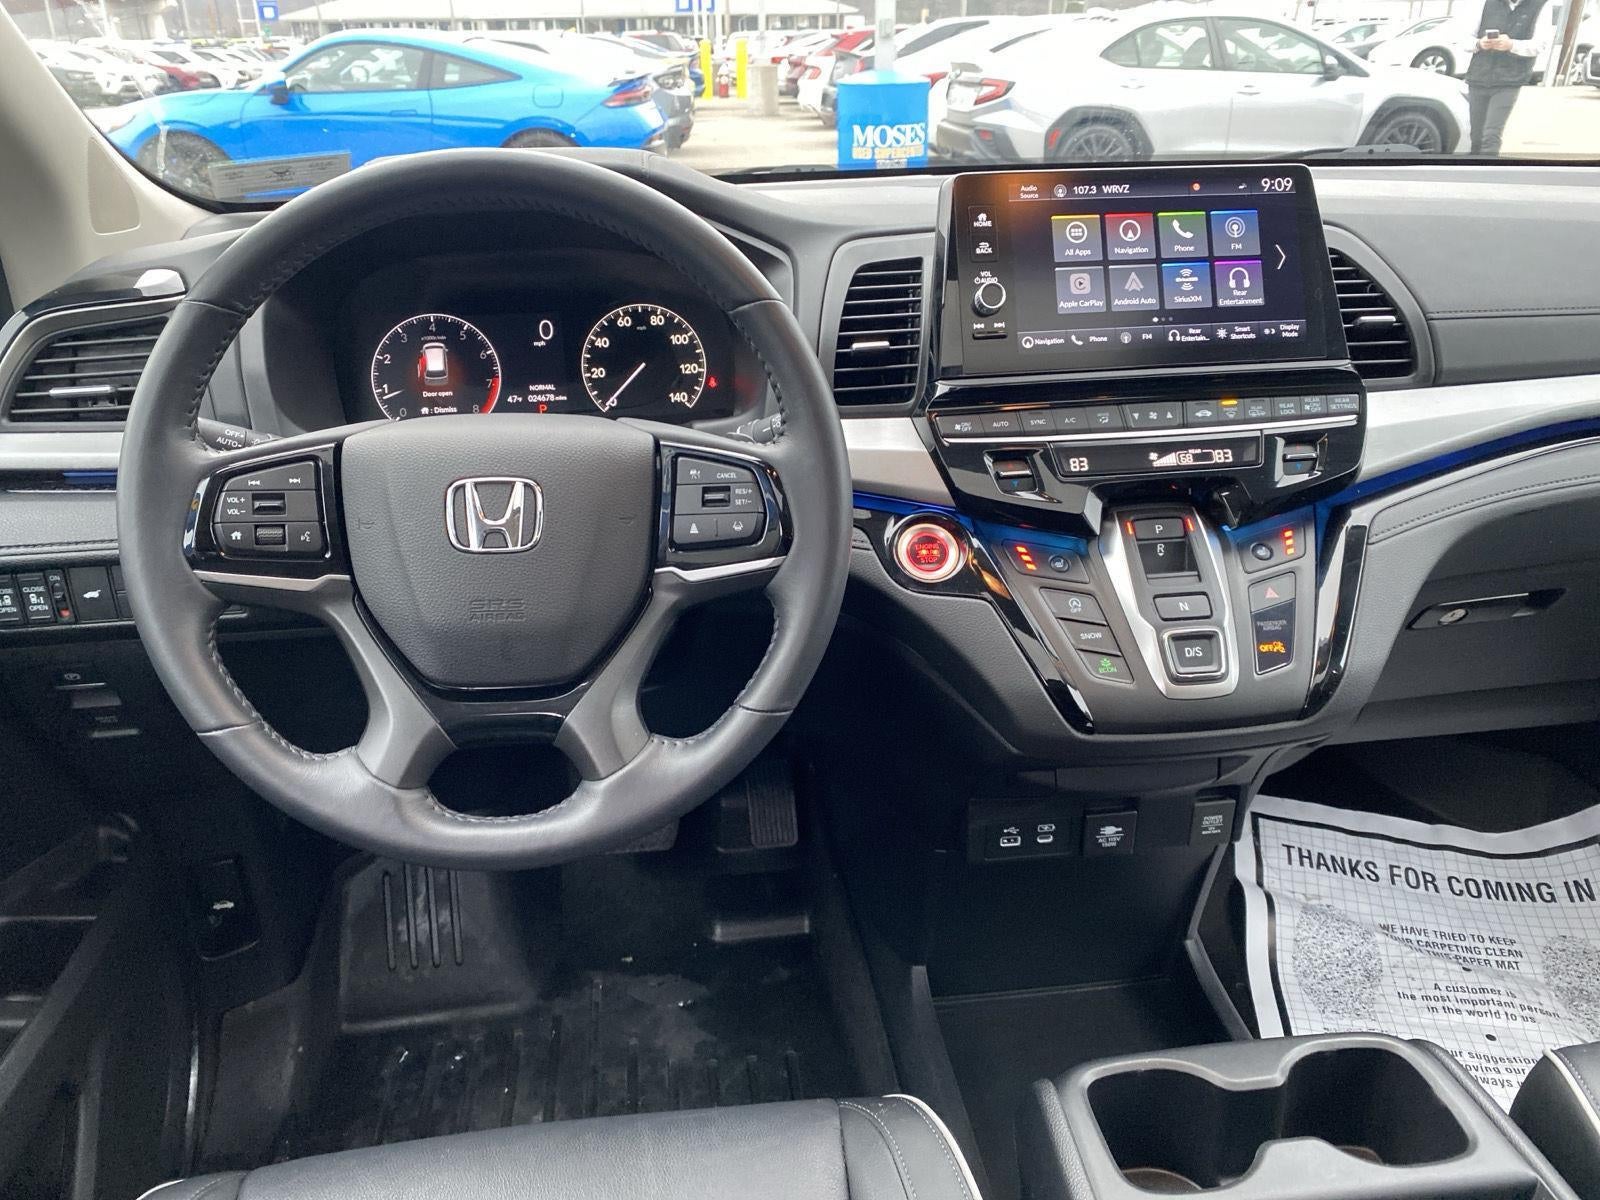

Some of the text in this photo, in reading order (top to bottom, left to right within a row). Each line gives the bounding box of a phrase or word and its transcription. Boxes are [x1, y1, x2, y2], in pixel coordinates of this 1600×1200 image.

[852, 122, 926, 148] MOSES
[1073, 184, 1130, 194] 107.3 WRVZ
[1262, 177, 1292, 192] 9:09
[1074, 248, 1091, 257] Apps
[1114, 246, 1148, 256] Navigation
[1079, 300, 1104, 308] CarPlay
[1174, 296, 1202, 304] SiriusXM
[616, 316, 632, 327] 60
[650, 315, 665, 326] 80
[428, 323, 436, 332] 4
[539, 320, 554, 340] 0
[400, 334, 408, 342] 3
[460, 330, 466, 340] 5
[670, 334, 689, 344] 100
[594, 337, 610, 348] 40
[1034, 338, 1065, 346] Navigation
[384, 354, 392, 364] 2
[480, 350, 487, 360] 6
[590, 368, 606, 378] 20
[680, 363, 698, 374] 120
[528, 394, 555, 402] 024678
[669, 392, 688, 403] 140
[400, 408, 407, 417] 0
[472, 404, 480, 414] 8
[539, 404, 548, 414] P
[224, 428, 240, 438] OFF
[216, 436, 238, 448] AUTO
[1178, 454, 1193, 463] 68
[1215, 449, 1233, 463] 83
[1070, 458, 1088, 472] 83
[1155, 524, 1164, 534] P
[1156, 544, 1165, 553] R
[1179, 602, 1190, 612] N
[1185, 646, 1203, 657] D/S
[1260, 644, 1274, 652] OFF
[1099, 666, 1117, 674] ECON
[1282, 843, 1597, 903] THANKS FOR COMING IN
[1378, 922, 1517, 947] WE HAVE TRIED TO KEEP
[1416, 940, 1482, 956] CARPETING
[1484, 947, 1524, 958] CLEAN
[1454, 954, 1492, 968] PAPER
[1495, 960, 1520, 971] MAT
[1434, 982, 1518, 999] A customer is
[1398, 990, 1560, 1019] the most important person
[1426, 1005, 1537, 1024] in the world to us
[1460, 1063, 1526, 1076] oving our
